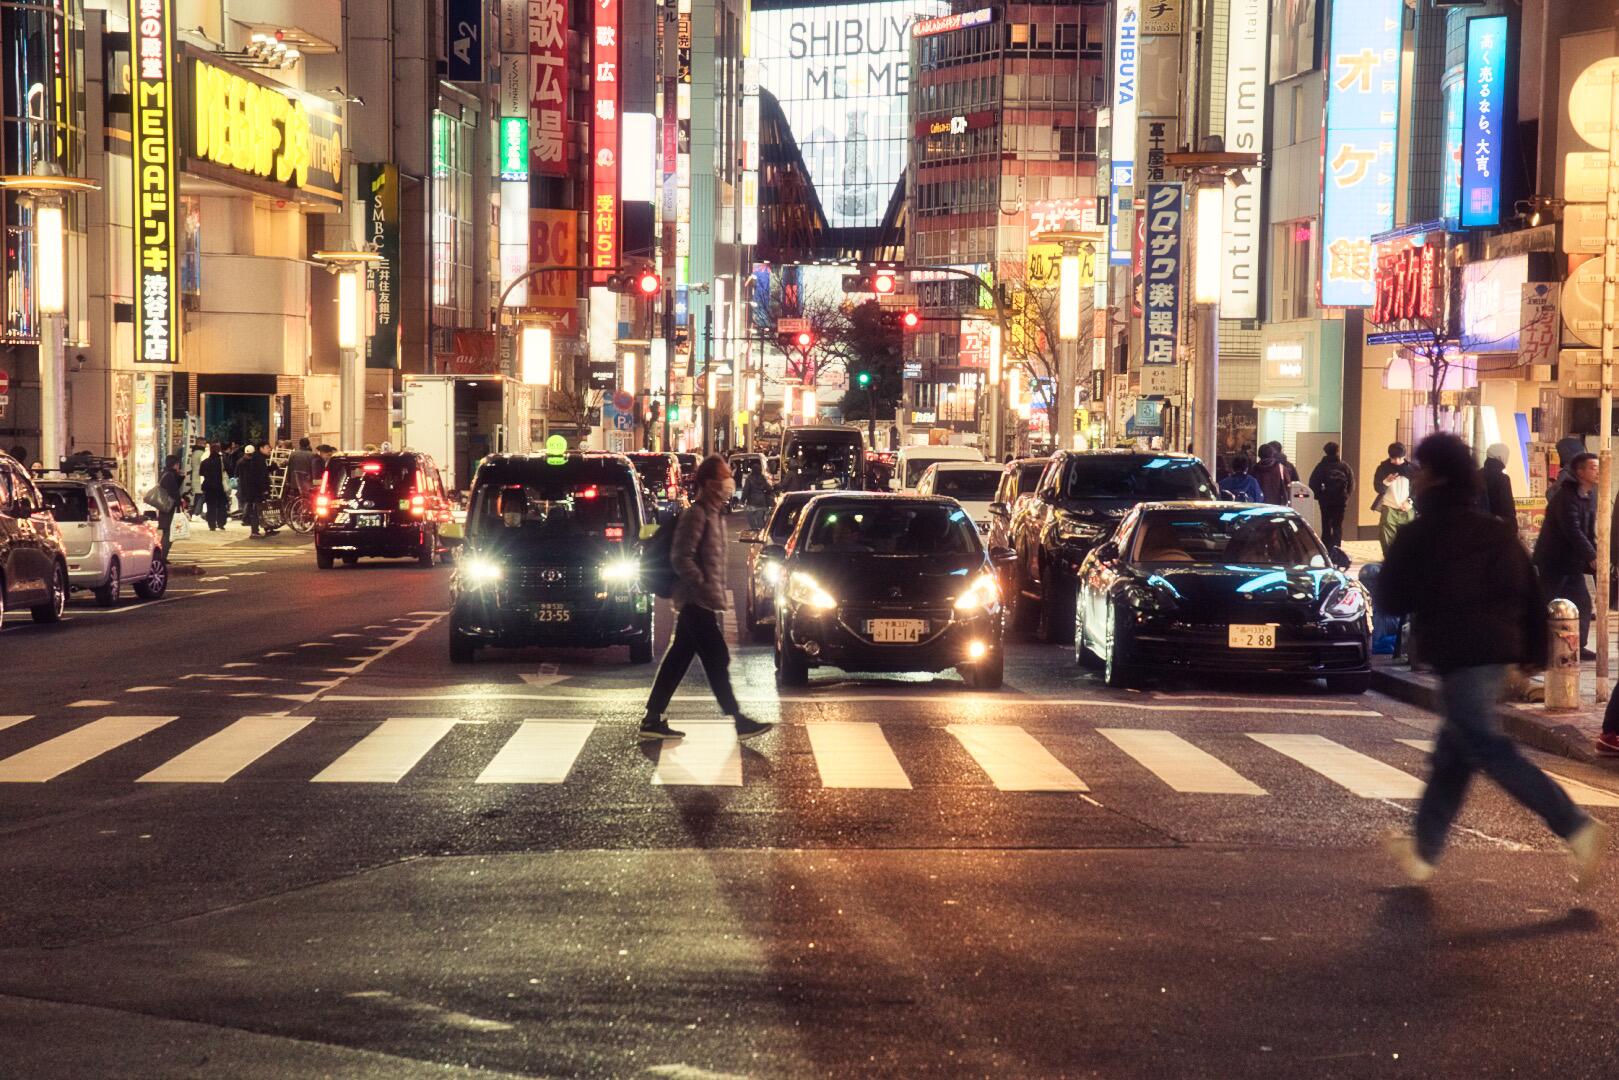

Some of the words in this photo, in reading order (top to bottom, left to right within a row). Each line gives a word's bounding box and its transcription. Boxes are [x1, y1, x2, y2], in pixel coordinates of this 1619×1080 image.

[453, 21, 477, 64] A2
[1119, 11, 1136, 104] SHIBUYA
[529, 0, 564, 162] 歌広場
[140, 81, 168, 272] MEGAドンキ
[1231, 66, 1256, 294] intimsimi
[373, 195, 386, 248] SMBC
[379, 259, 390, 324] 三井住友銀行
[1030, 253, 1094, 281] 処方ん
[1147, 186, 1178, 363] クロサワ楽器店
[143, 275, 168, 360] 渋谷本店
[540, 610, 570, 621] 23-55
[885, 628, 916, 640] 11-14
